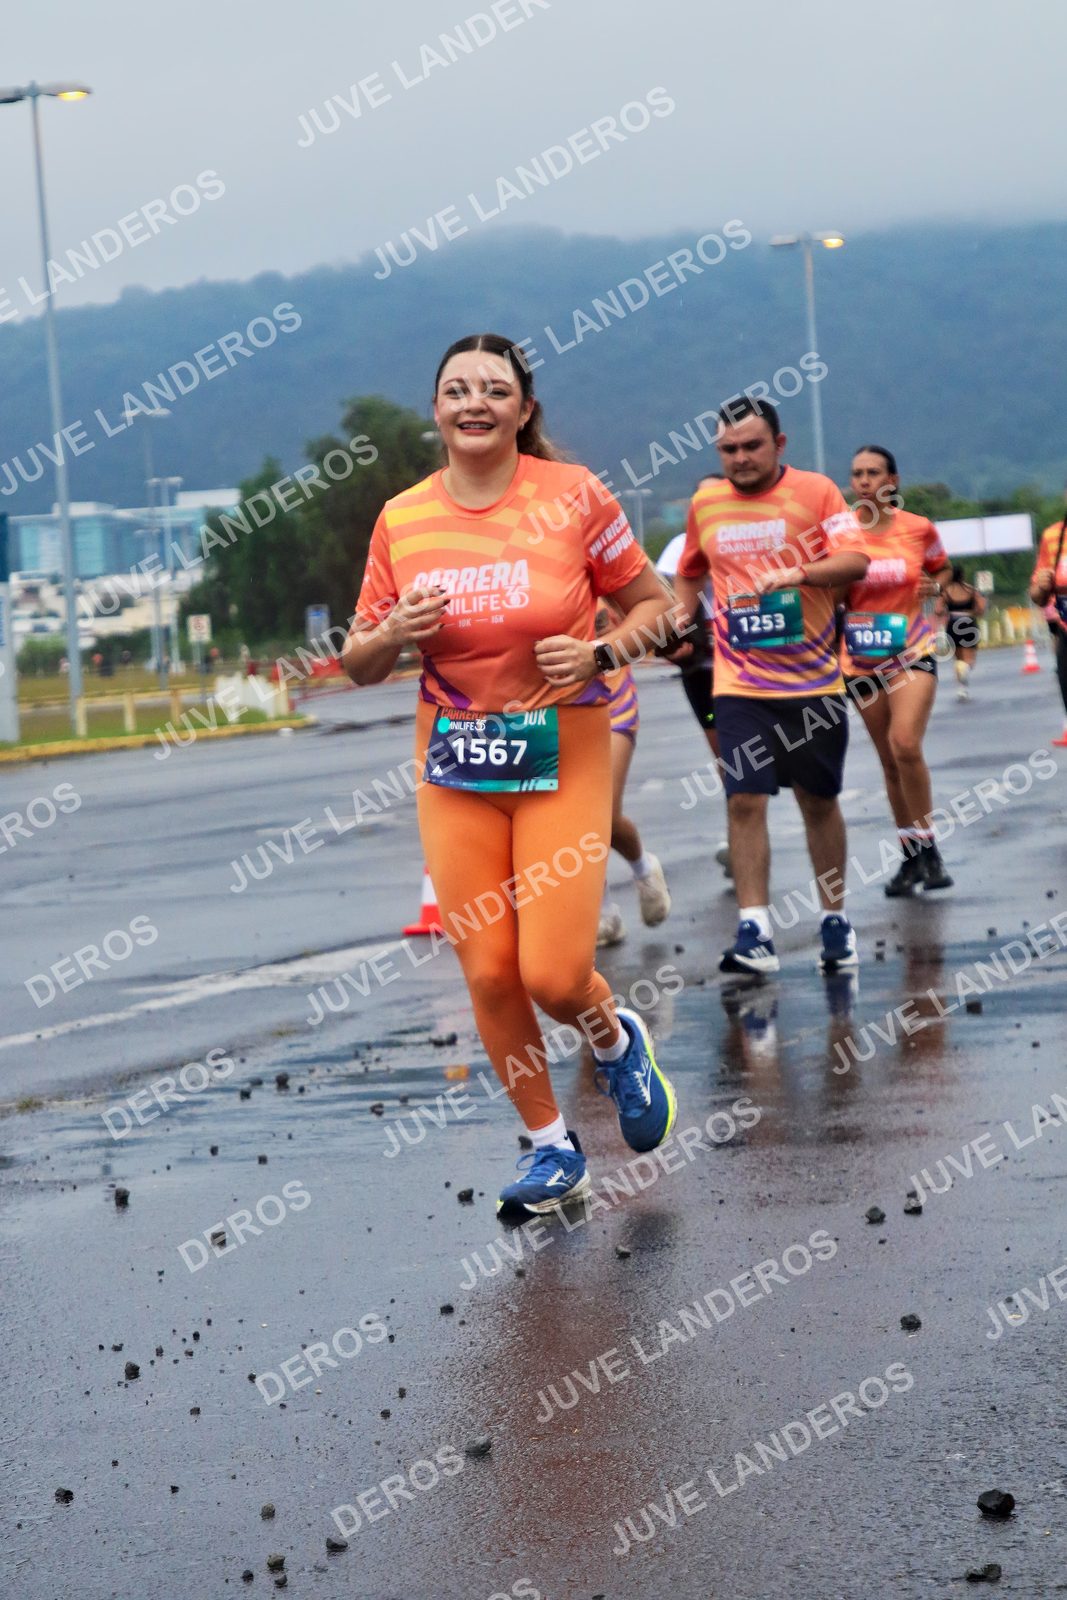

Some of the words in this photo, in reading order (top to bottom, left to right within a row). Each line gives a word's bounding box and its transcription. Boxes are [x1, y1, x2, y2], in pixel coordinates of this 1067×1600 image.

[739, 613, 786, 633] 1253
[853, 630, 893, 646] 1012
[452, 738, 528, 766] 1567
